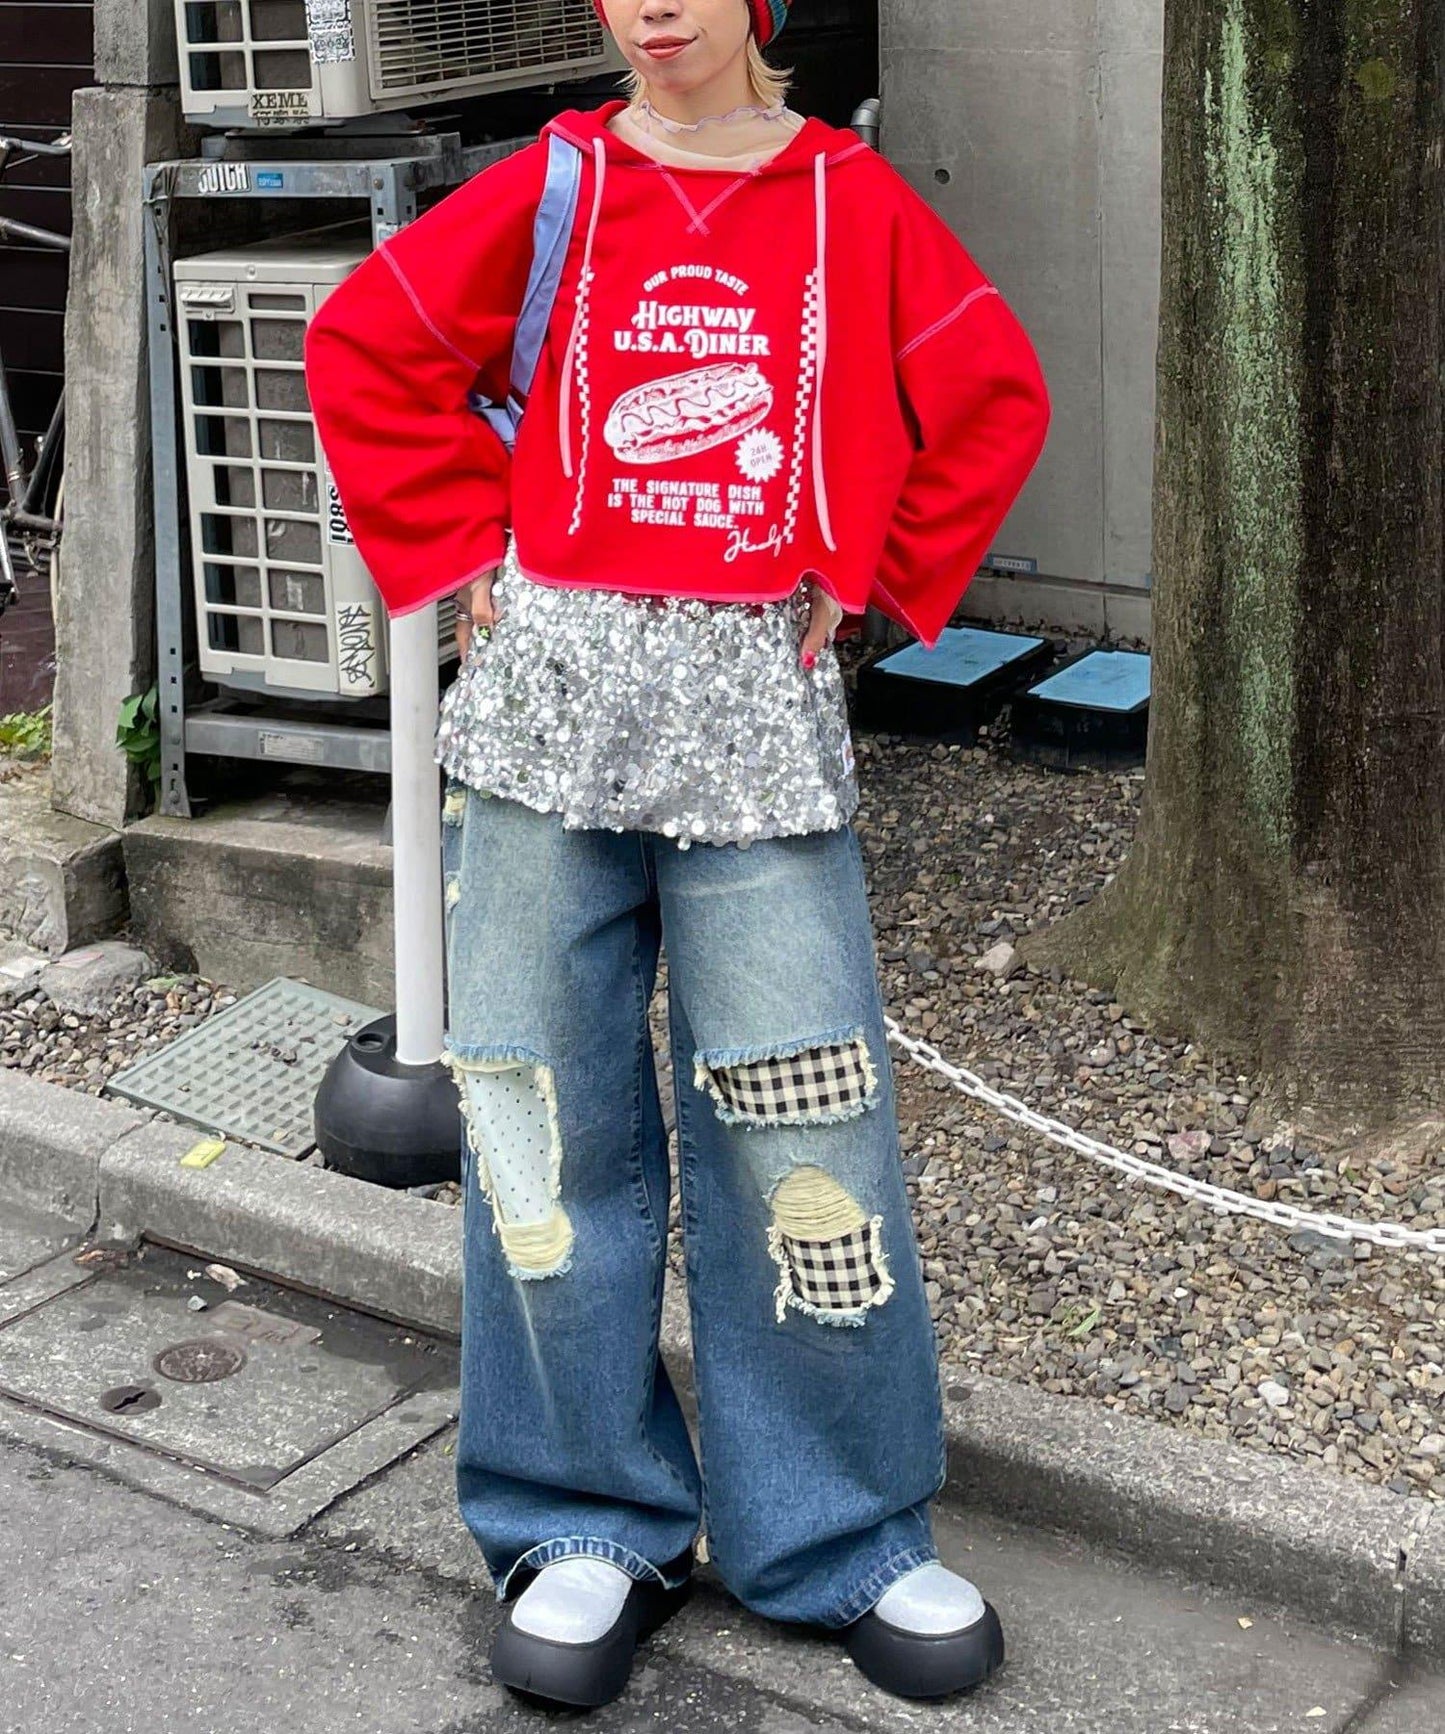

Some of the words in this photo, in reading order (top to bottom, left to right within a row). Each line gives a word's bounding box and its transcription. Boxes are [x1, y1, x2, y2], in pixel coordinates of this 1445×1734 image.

[643, 270, 668, 292] OUR
[670, 264, 713, 280] PROUD
[715, 268, 749, 296] TASTE
[614, 330, 685, 352] U.S.A.
[684, 328, 771, 359] DINER
[612, 478, 638, 493] THE
[646, 480, 720, 497] SIGNATURE
[728, 484, 762, 500] DISH
[607, 493, 623, 508] IS
[630, 493, 655, 508] THE
[662, 495, 689, 511] HOT
[696, 497, 721, 513] DOG
[729, 500, 765, 515] WITH
[631, 509, 686, 526] SPECIAL
[693, 513, 739, 529] SAUCE.
